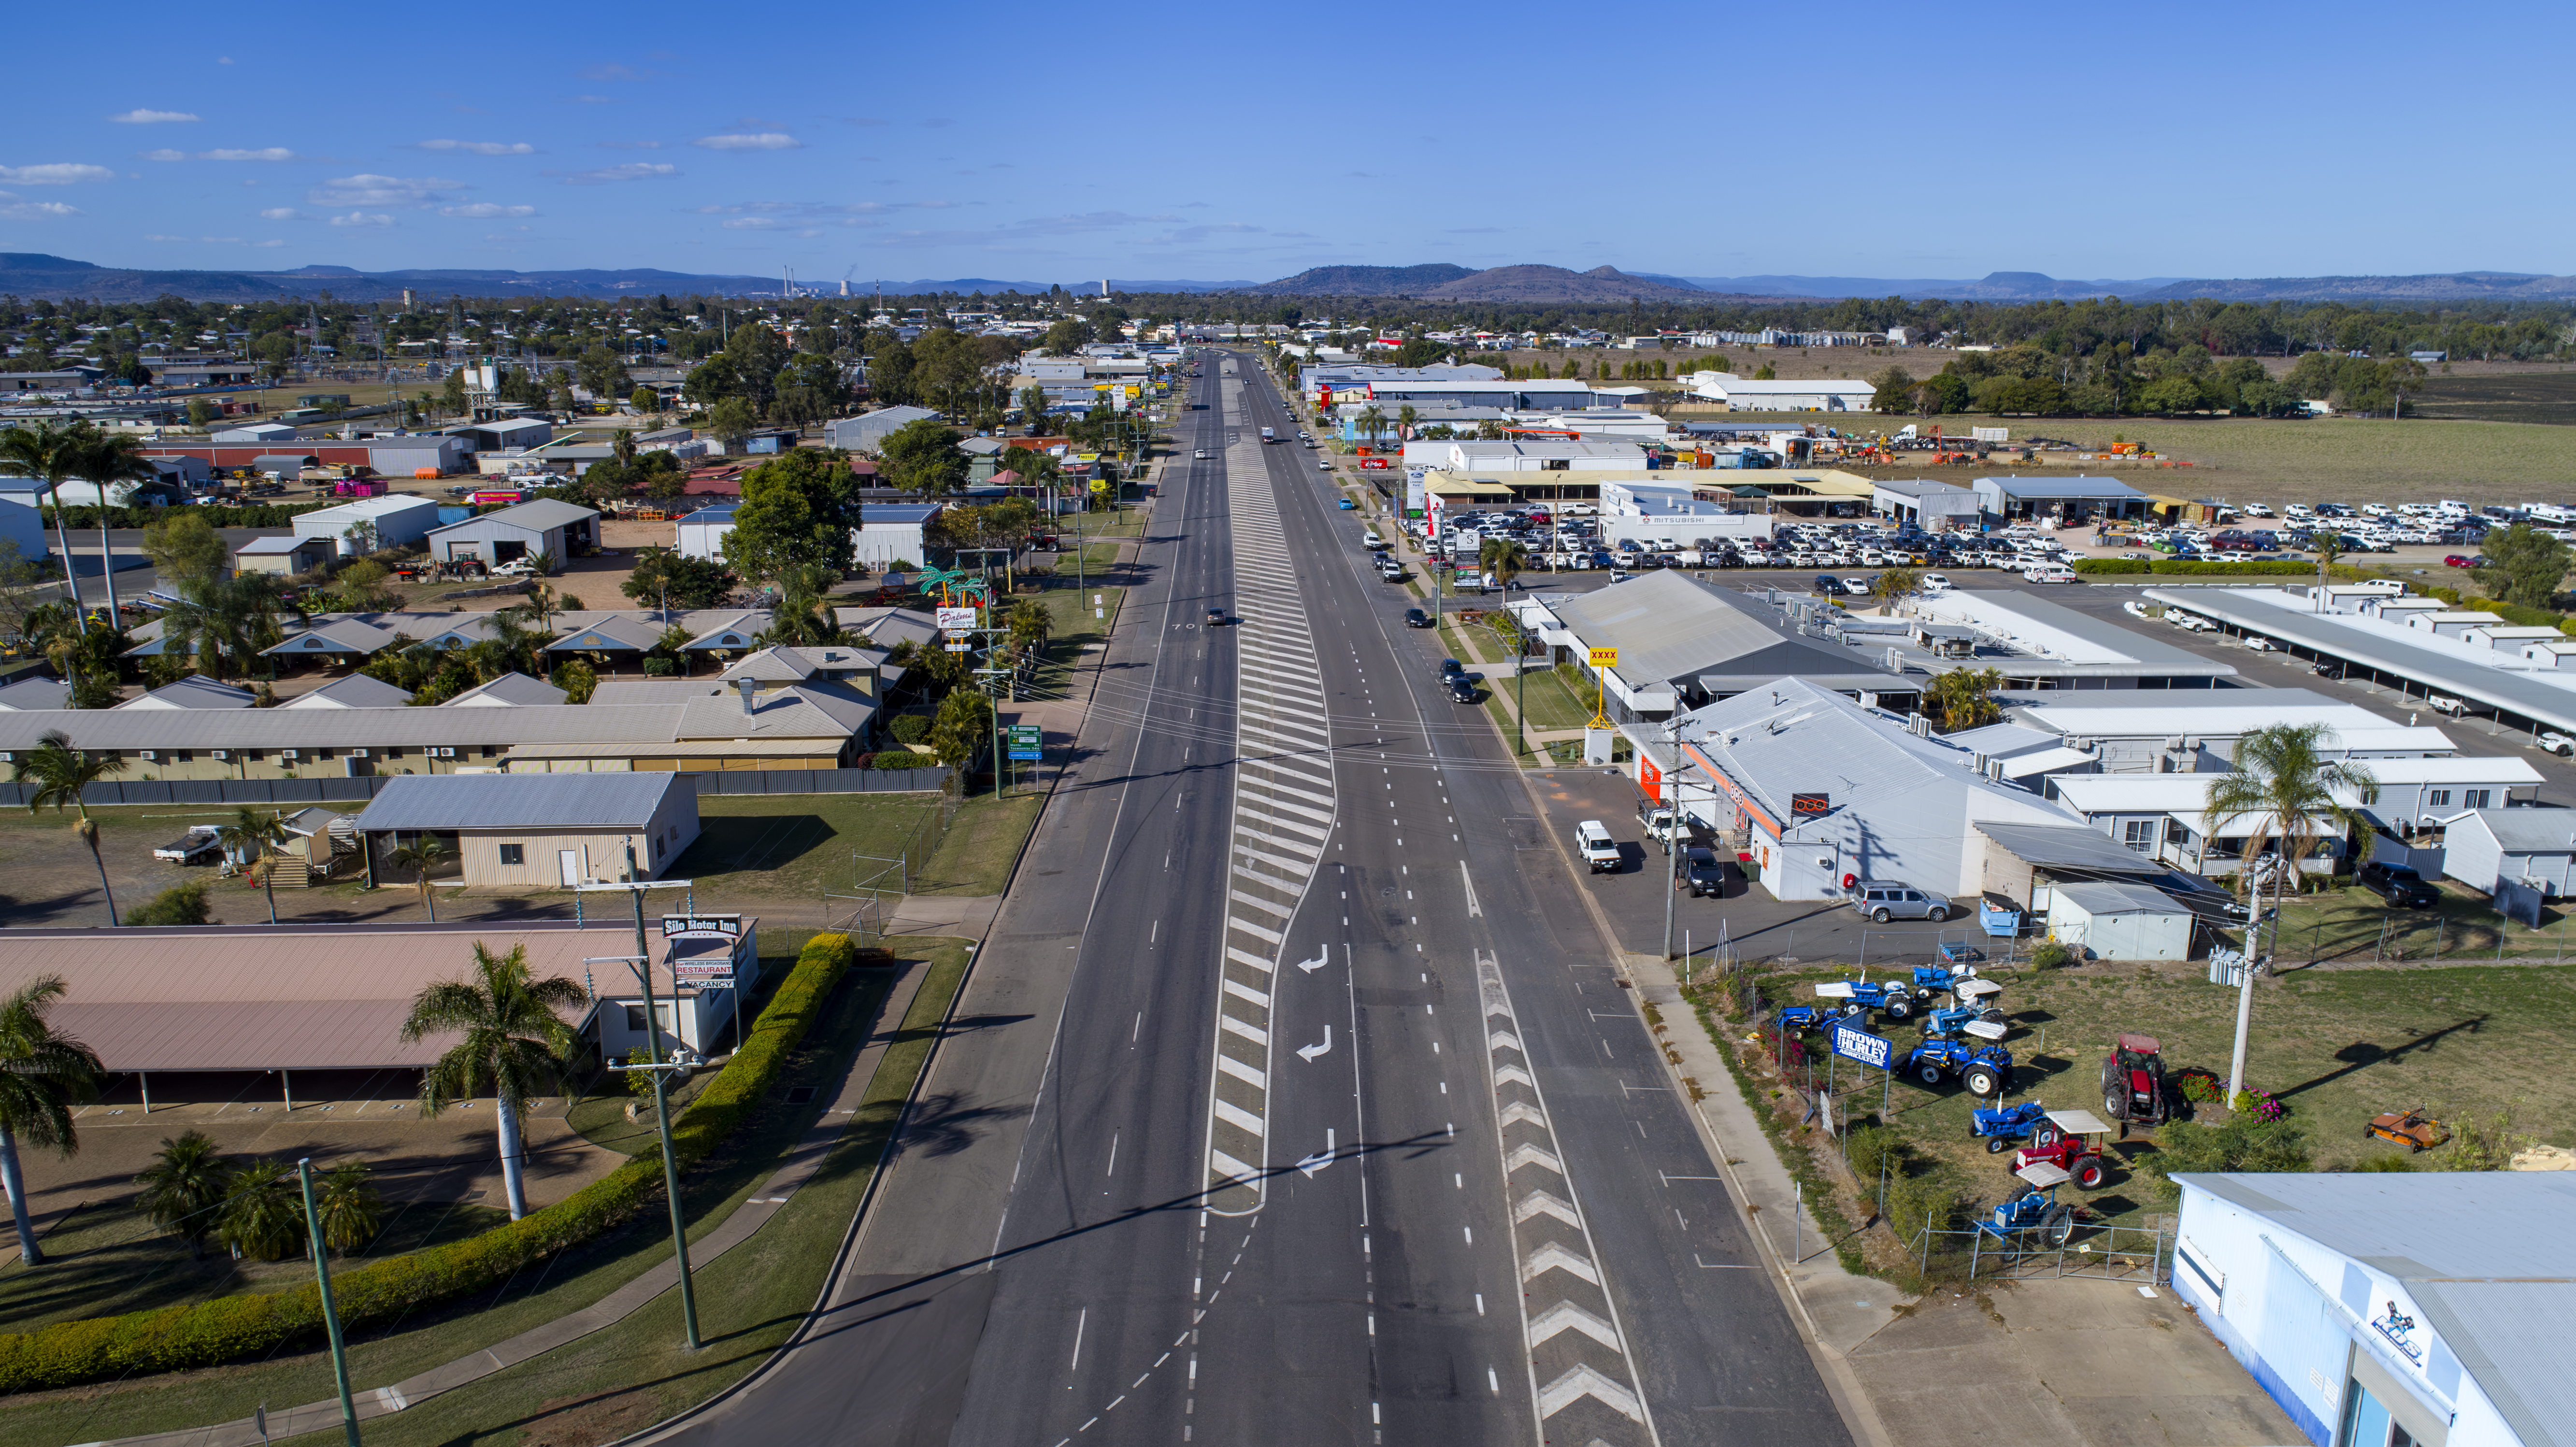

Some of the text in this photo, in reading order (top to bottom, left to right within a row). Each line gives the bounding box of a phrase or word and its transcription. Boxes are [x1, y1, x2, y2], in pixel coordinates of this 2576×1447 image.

[1731, 785, 1743, 804] BWS
[665, 920, 737, 934] Silo Motor Inn
[1838, 1027, 1888, 1051] BROWN
[1841, 1037, 1887, 1060] HURLEY
[1839, 1049, 1884, 1066] AGRICULTURE
[2374, 1316, 2422, 1358] KDS
